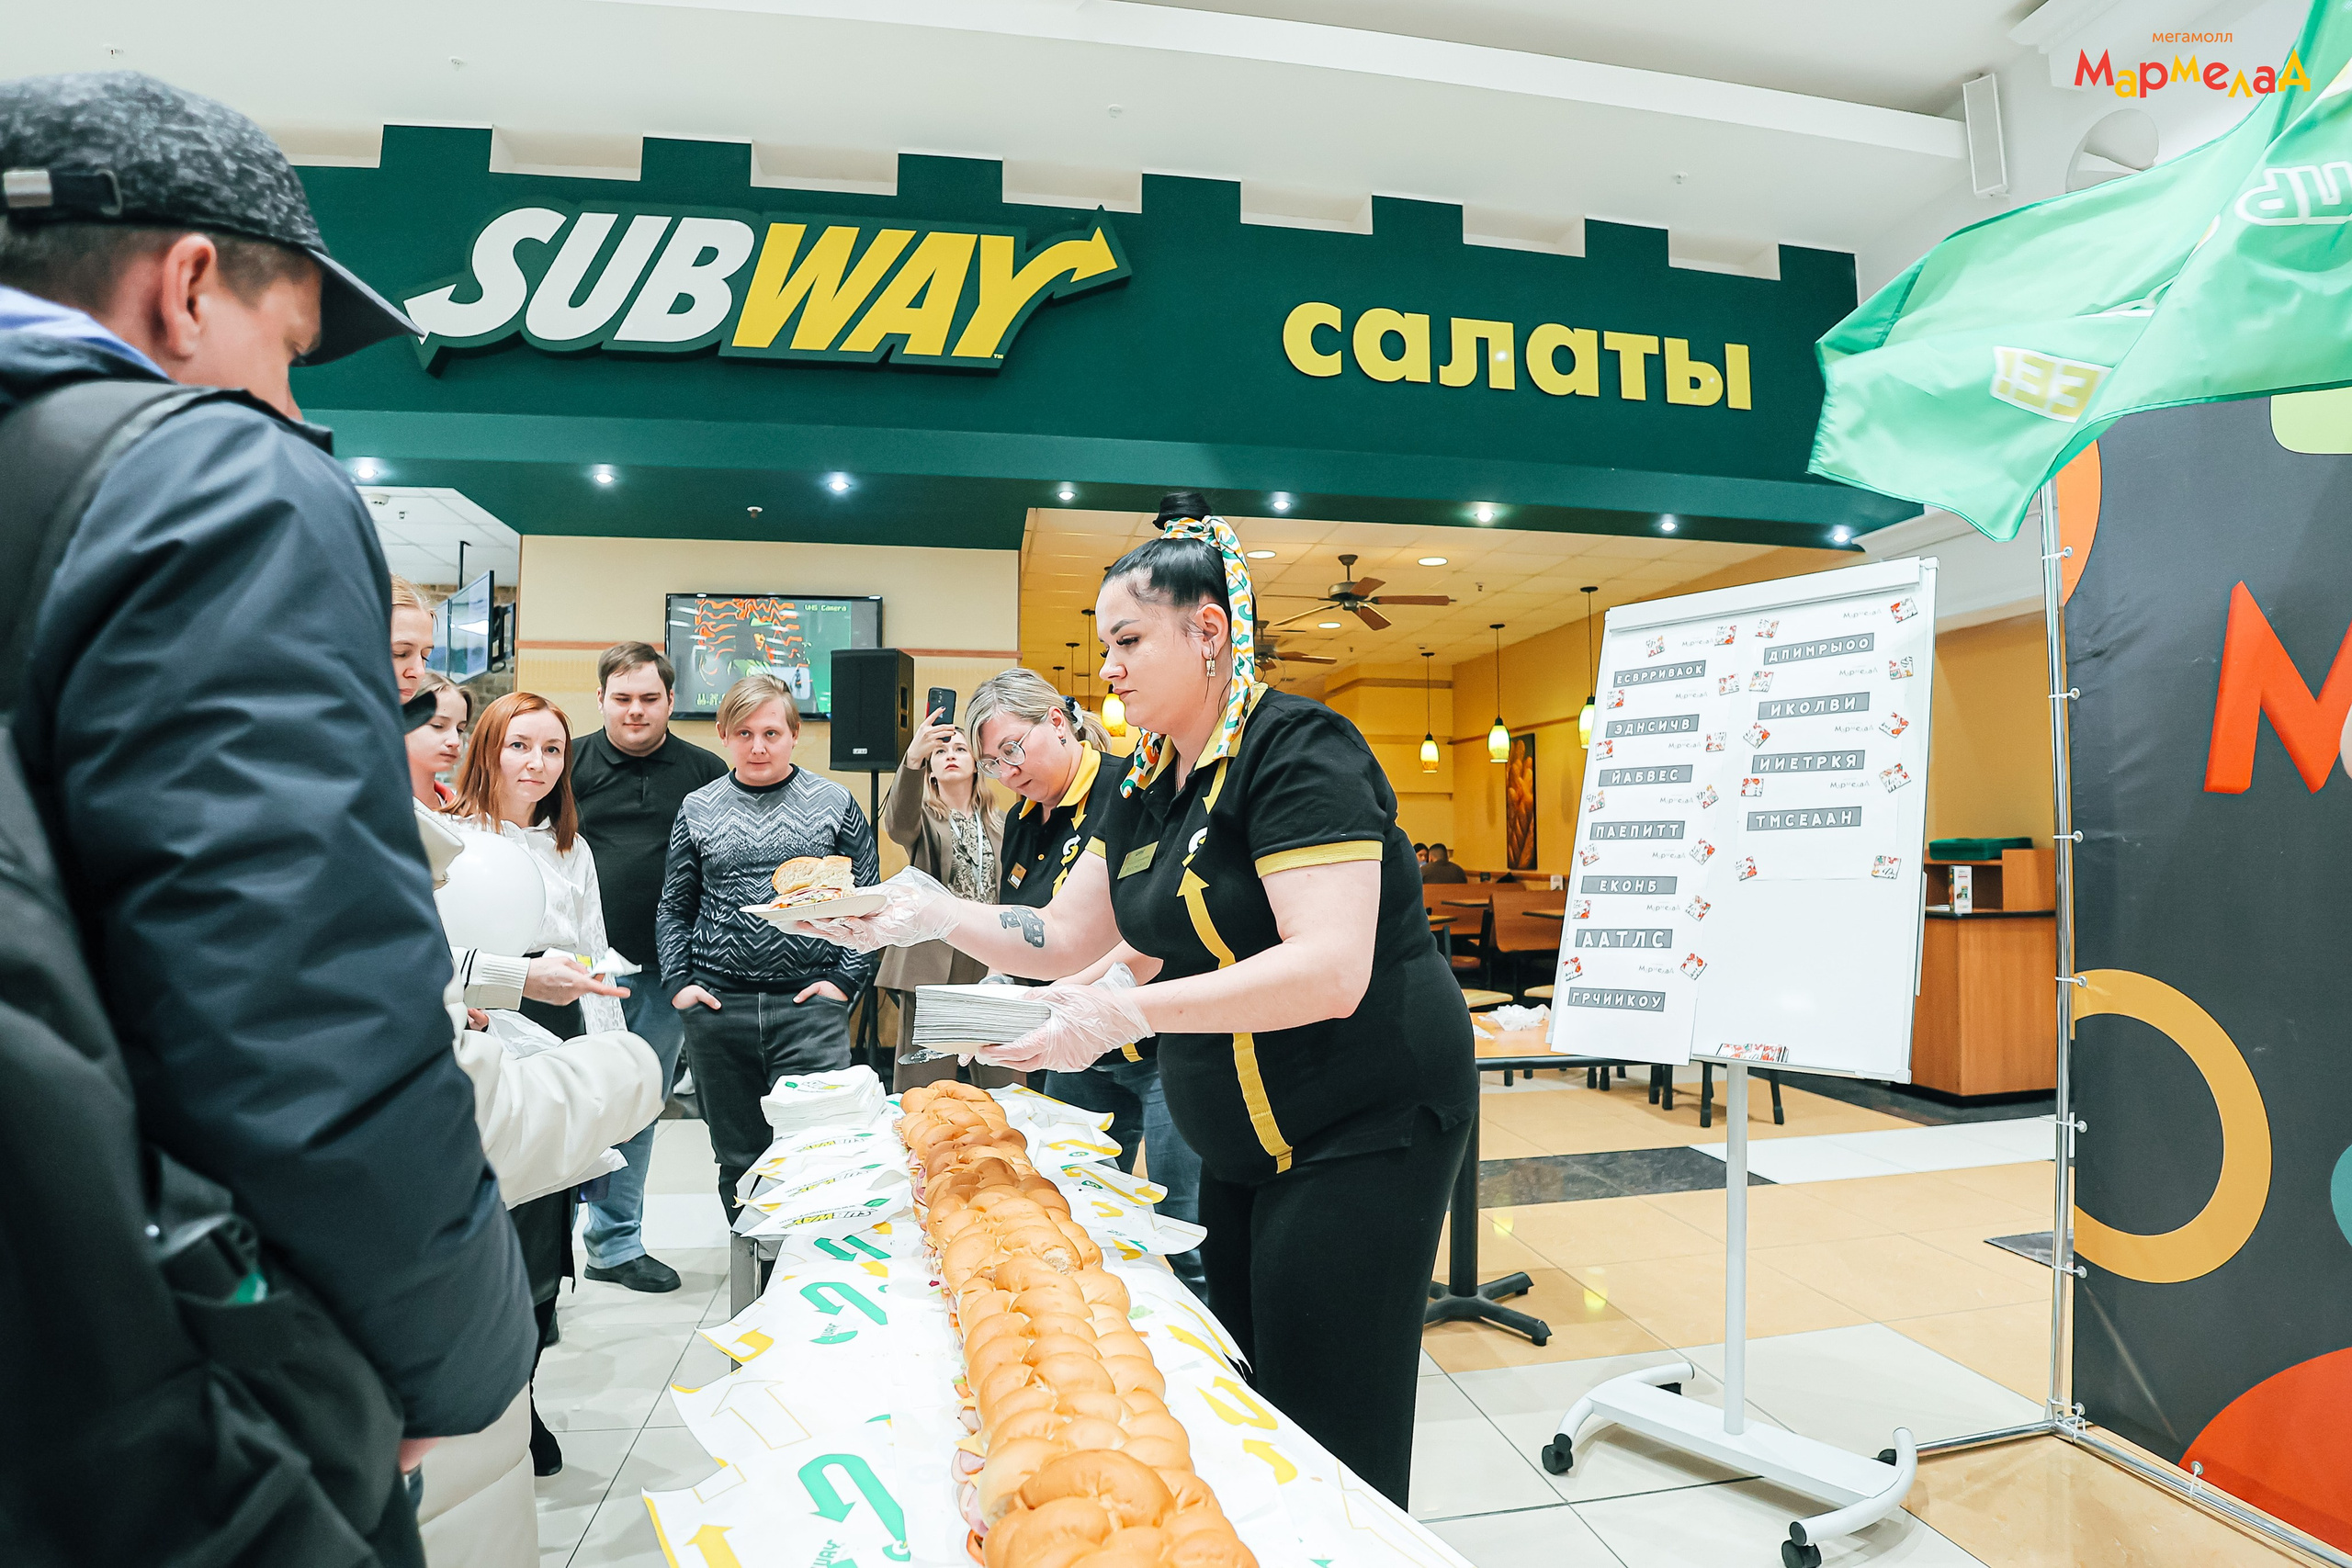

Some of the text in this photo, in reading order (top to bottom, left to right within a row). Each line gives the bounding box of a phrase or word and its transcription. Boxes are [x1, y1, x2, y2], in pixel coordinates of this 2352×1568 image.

[402, 206, 1118, 359] SUBWAY
[1283, 301, 1752, 411] салаты
[1768, 637, 1870, 662] ДПИМРЫОО
[1616, 664, 1703, 684] ЕСВРРИВАОК
[1770, 696, 1857, 716] ИКОЛВИ
[1614, 718, 1690, 736] ЭДНСИЧВ
[1758, 754, 1858, 771] ИИЕТРКЯ
[1611, 769, 1679, 784] ЙАБВЕС
[1756, 810, 1852, 828] ТМСЕААН
[1595, 824, 1679, 838] ПАЕПИТТ
[1600, 879, 1657, 892] ЕКОНБ
[1582, 931, 1665, 948] ААТЛС
[1571, 991, 1661, 1009] ГРЧИИКОУ
